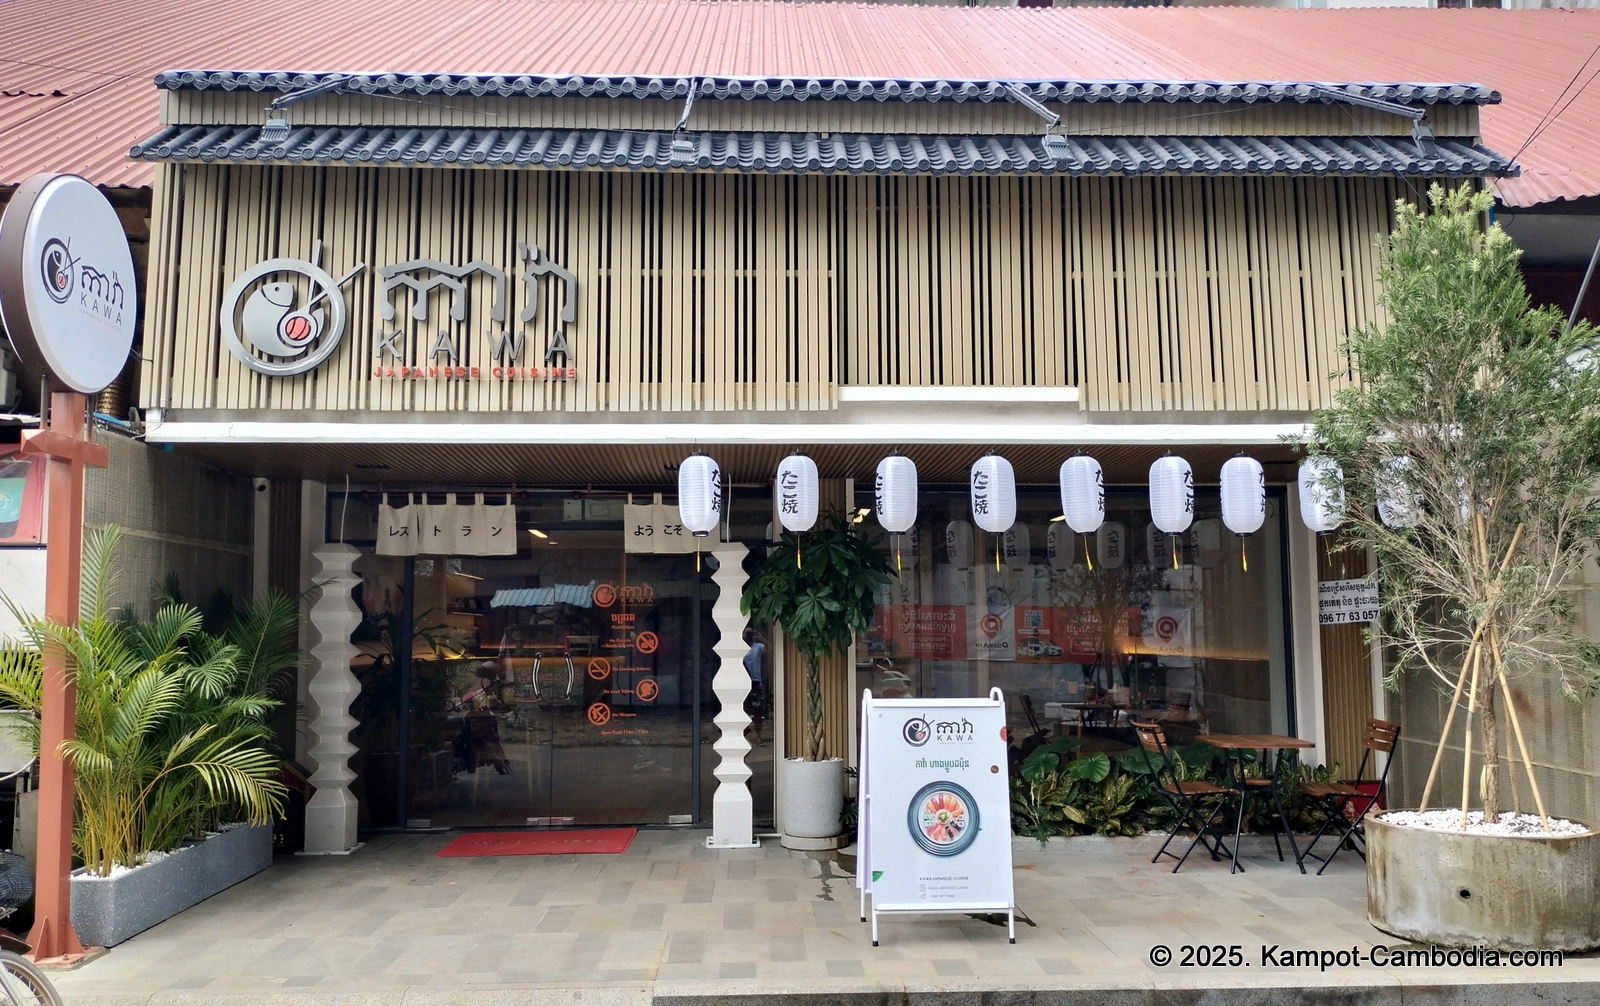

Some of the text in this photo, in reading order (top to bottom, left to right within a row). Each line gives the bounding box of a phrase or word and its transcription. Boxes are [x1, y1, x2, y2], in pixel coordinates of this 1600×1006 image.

[80, 292, 122, 326] KAWA
[376, 330, 572, 361] KAWA
[373, 366, 576, 379] JAPANESE CUISINE
[781, 470, 798, 514] たこ焼
[974, 470, 989, 515] たこ焼
[1319, 610, 1379, 623] 096 77 63 057
